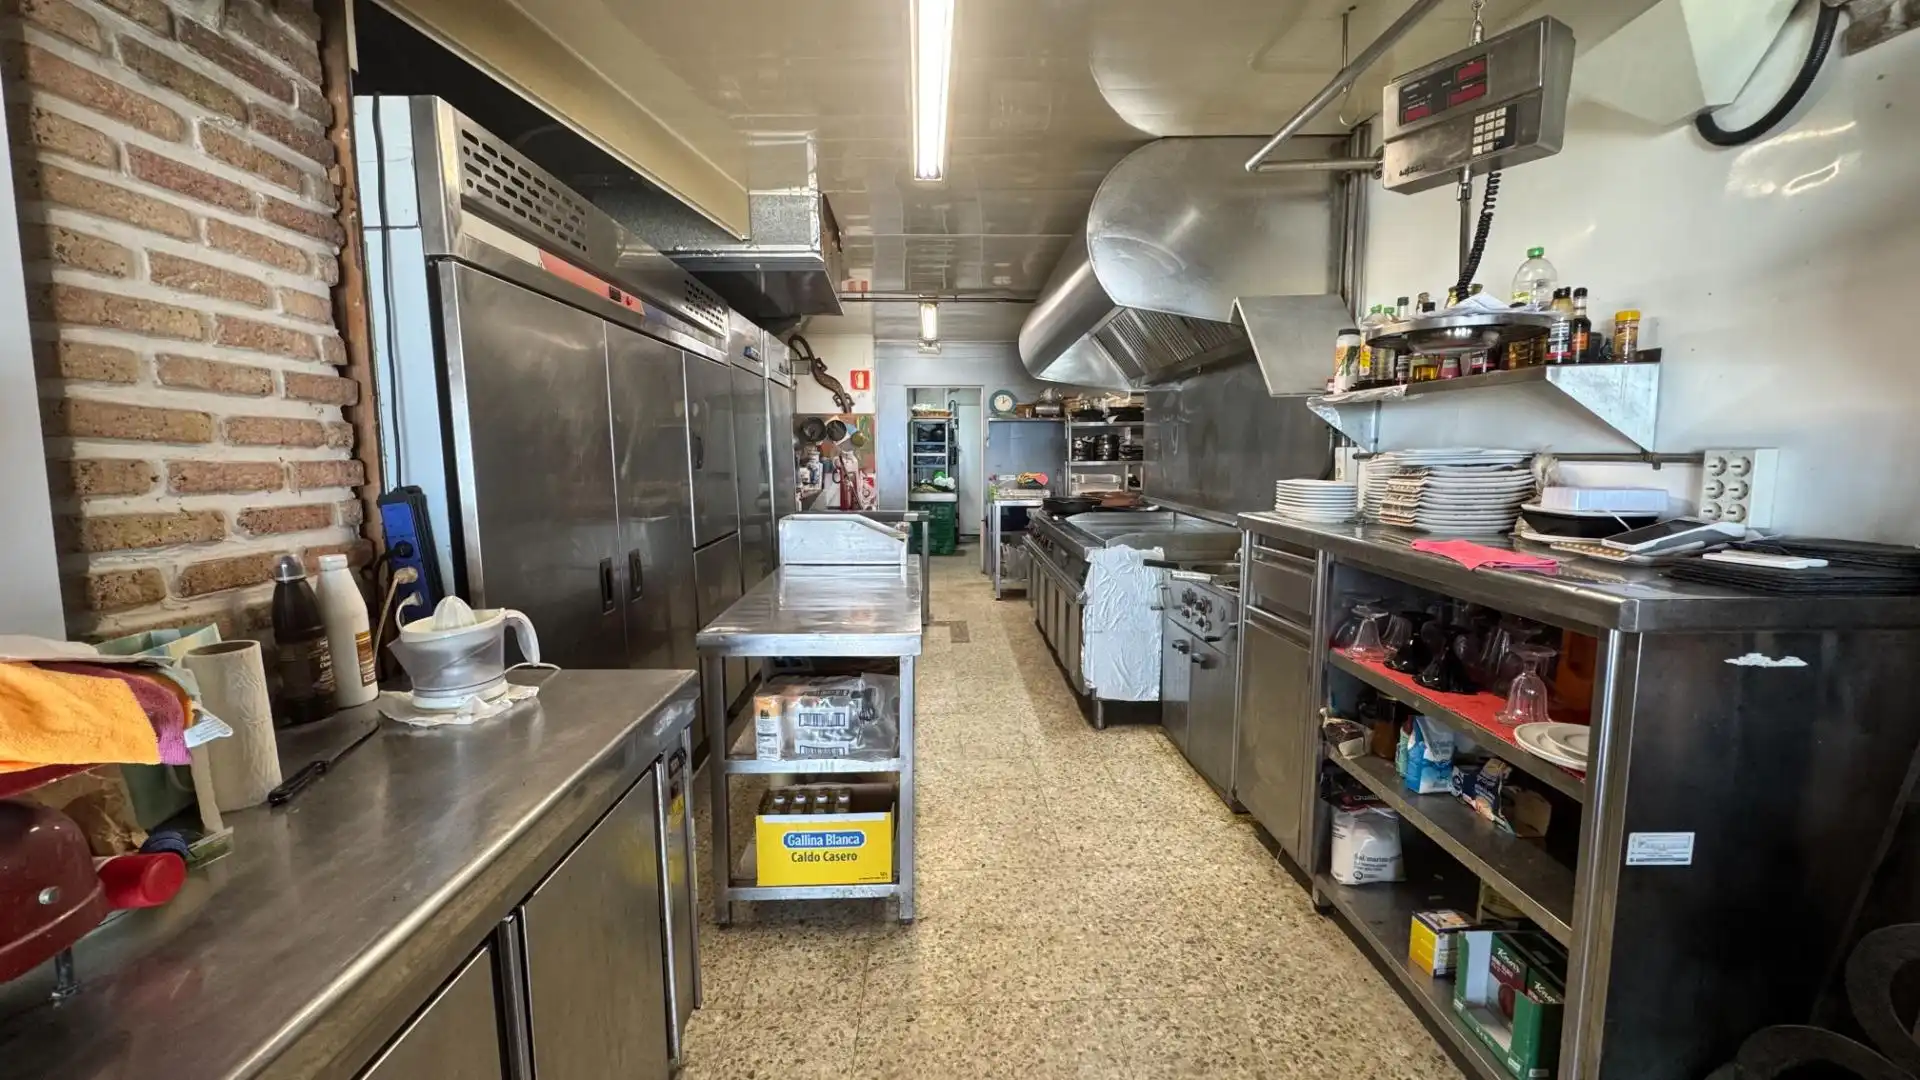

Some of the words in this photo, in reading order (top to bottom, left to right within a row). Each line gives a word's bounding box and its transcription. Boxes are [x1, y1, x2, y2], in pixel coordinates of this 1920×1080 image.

[787, 834, 823, 846] Gallina
[825, 833, 860, 846] Blanca
[791, 851, 820, 863] Caldo
[823, 850, 857, 862] Casero
